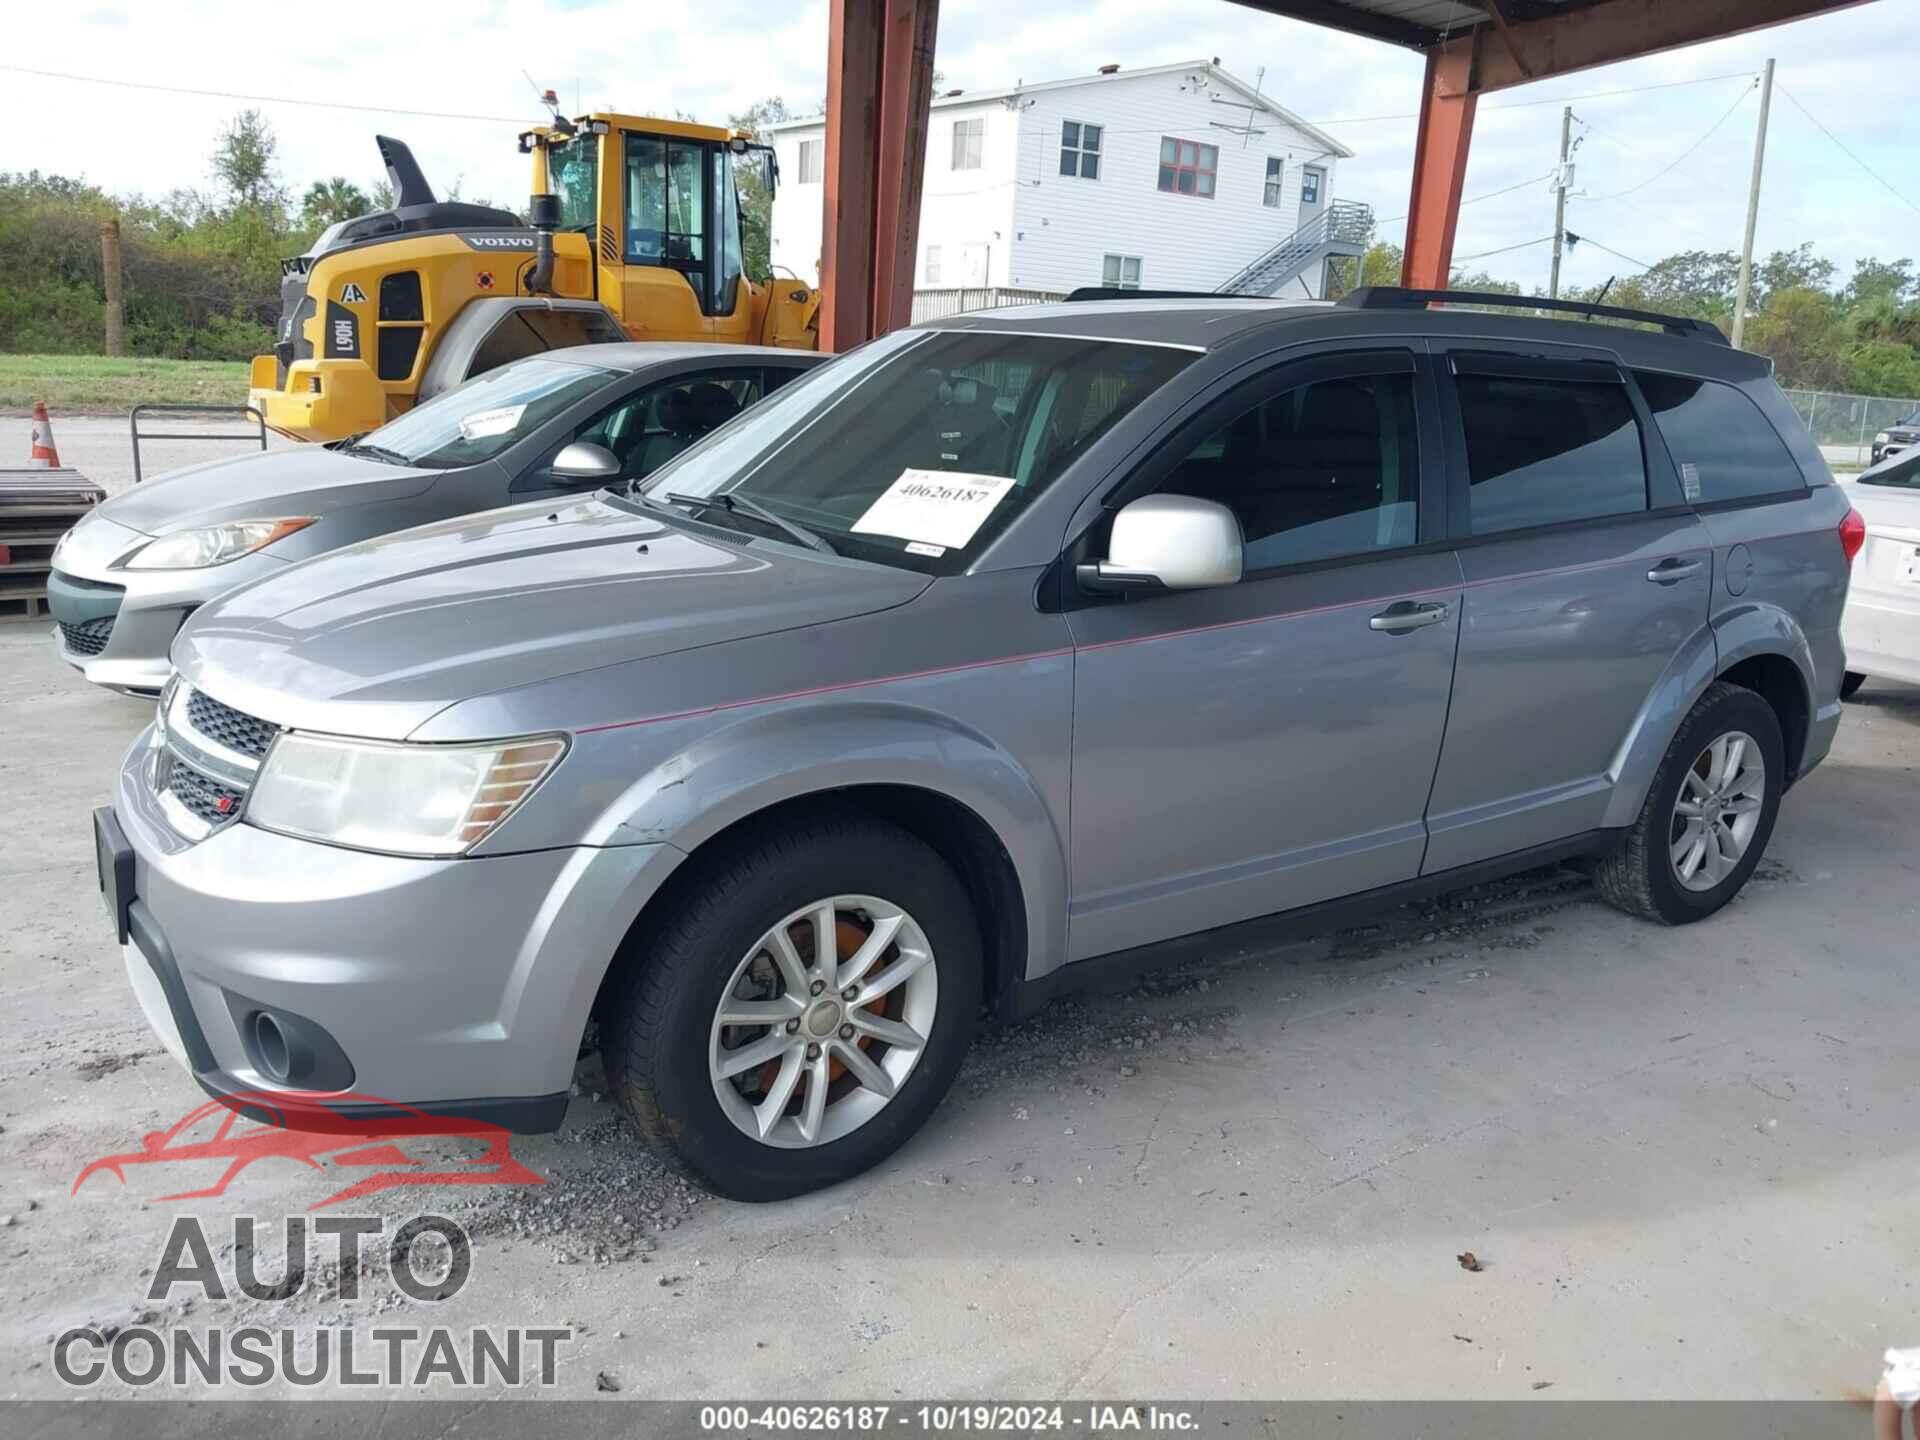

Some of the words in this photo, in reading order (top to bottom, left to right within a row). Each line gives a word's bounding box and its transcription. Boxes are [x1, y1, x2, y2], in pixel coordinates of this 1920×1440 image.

[469, 237, 534, 247] VOLVO
[335, 320, 354, 351] L90H
[900, 483, 990, 503] 40626187
